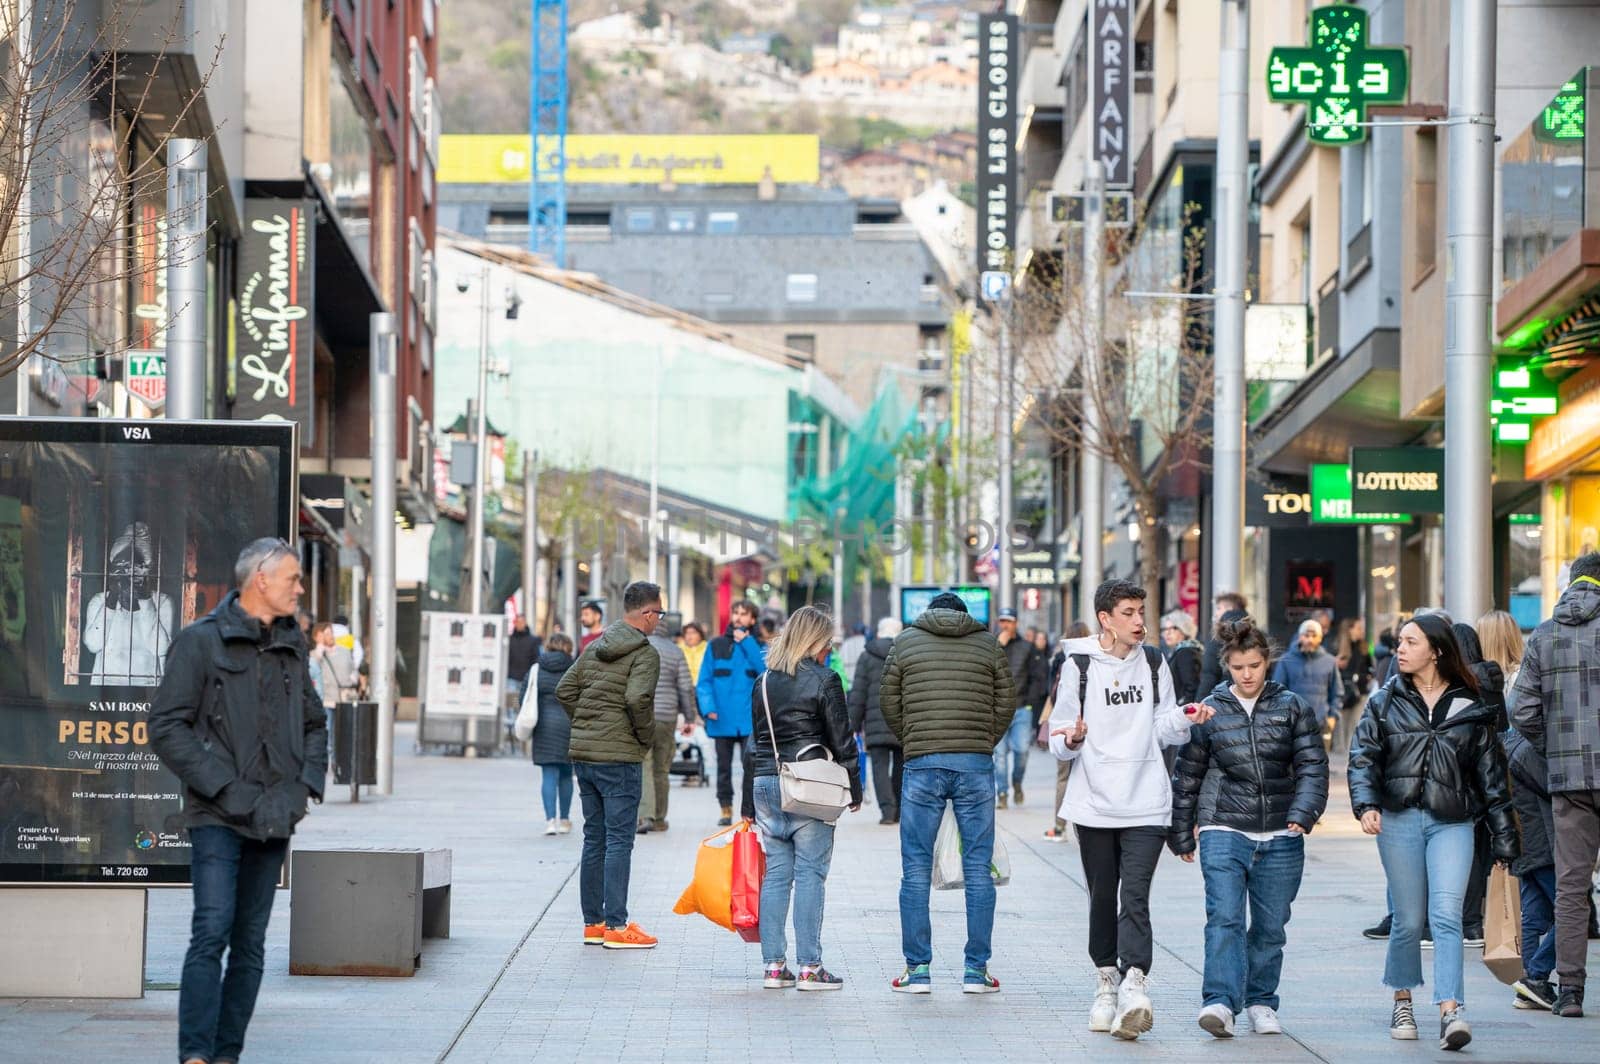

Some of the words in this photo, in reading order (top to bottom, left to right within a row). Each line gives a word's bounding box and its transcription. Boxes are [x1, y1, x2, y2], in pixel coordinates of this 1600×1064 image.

[988, 21, 1009, 118] CLOSES
[987, 128, 1008, 175] LES
[130, 377, 166, 401] HEUE
[1356, 472, 1439, 491] LOTTUSSE
[1104, 685, 1143, 706] levi's
[88, 701, 116, 712] SAM
[92, 752, 125, 761] mezzo
[126, 751, 144, 761] del
[144, 753, 160, 761] ca
[94, 761, 104, 769] di
[106, 762, 138, 770] nostra
[101, 866, 115, 876] Tel.
[117, 866, 132, 876] 720
[133, 866, 149, 876] 620
